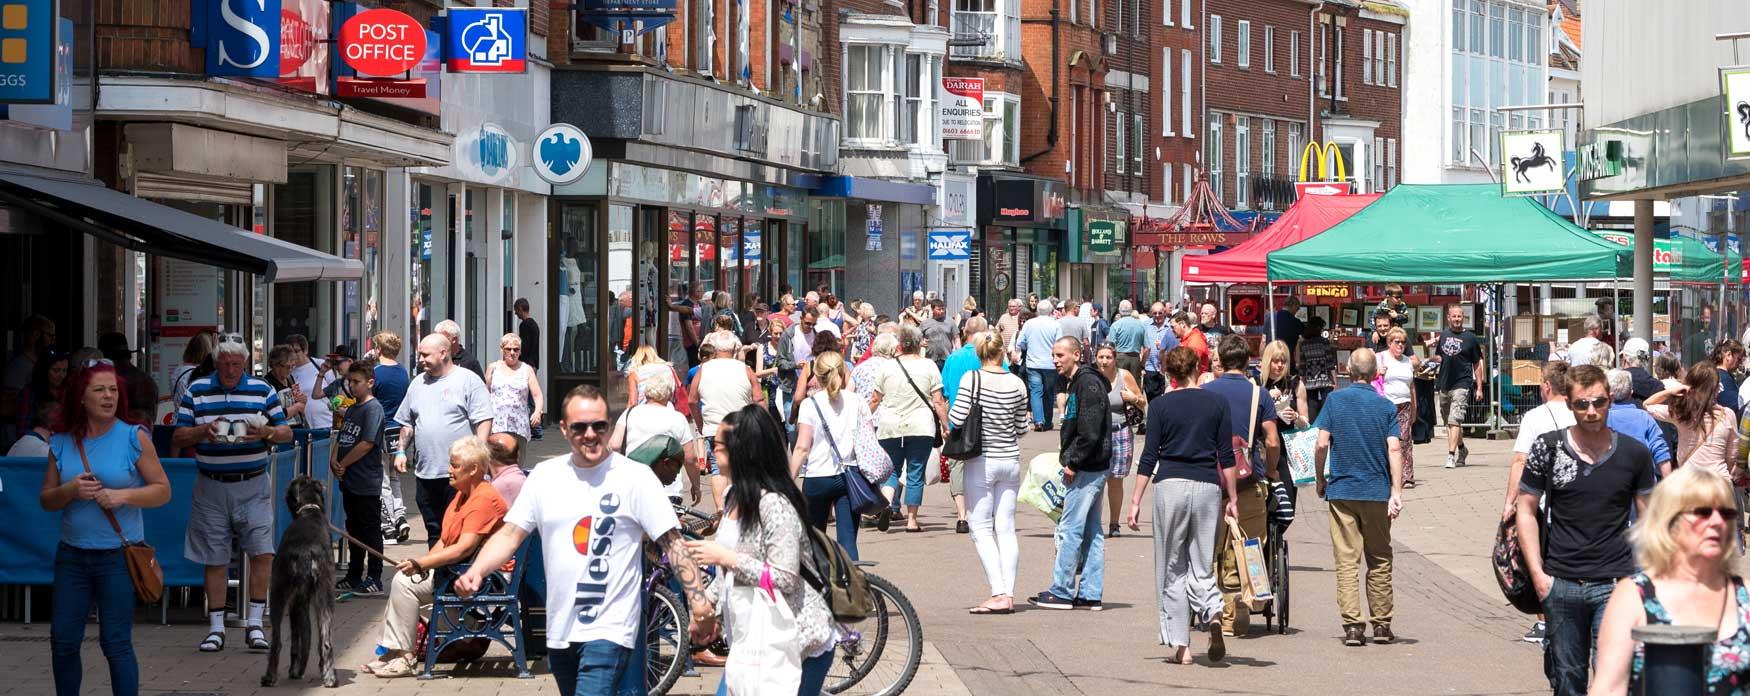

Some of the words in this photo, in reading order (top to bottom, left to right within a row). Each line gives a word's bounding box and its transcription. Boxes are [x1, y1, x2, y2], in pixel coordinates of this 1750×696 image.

[359, 23, 409, 41] POST
[346, 43, 415, 61] OFFICE
[352, 85, 378, 94] Travel
[380, 86, 411, 96] Money
[955, 99, 968, 107] ALL
[942, 108, 981, 117] ENQUIRIES
[1000, 207, 1029, 216] Hughes
[1158, 233, 1185, 243] THE
[1190, 233, 1226, 243] ROWS
[930, 241, 968, 249] HALIFAX
[574, 492, 621, 625] ellesse
